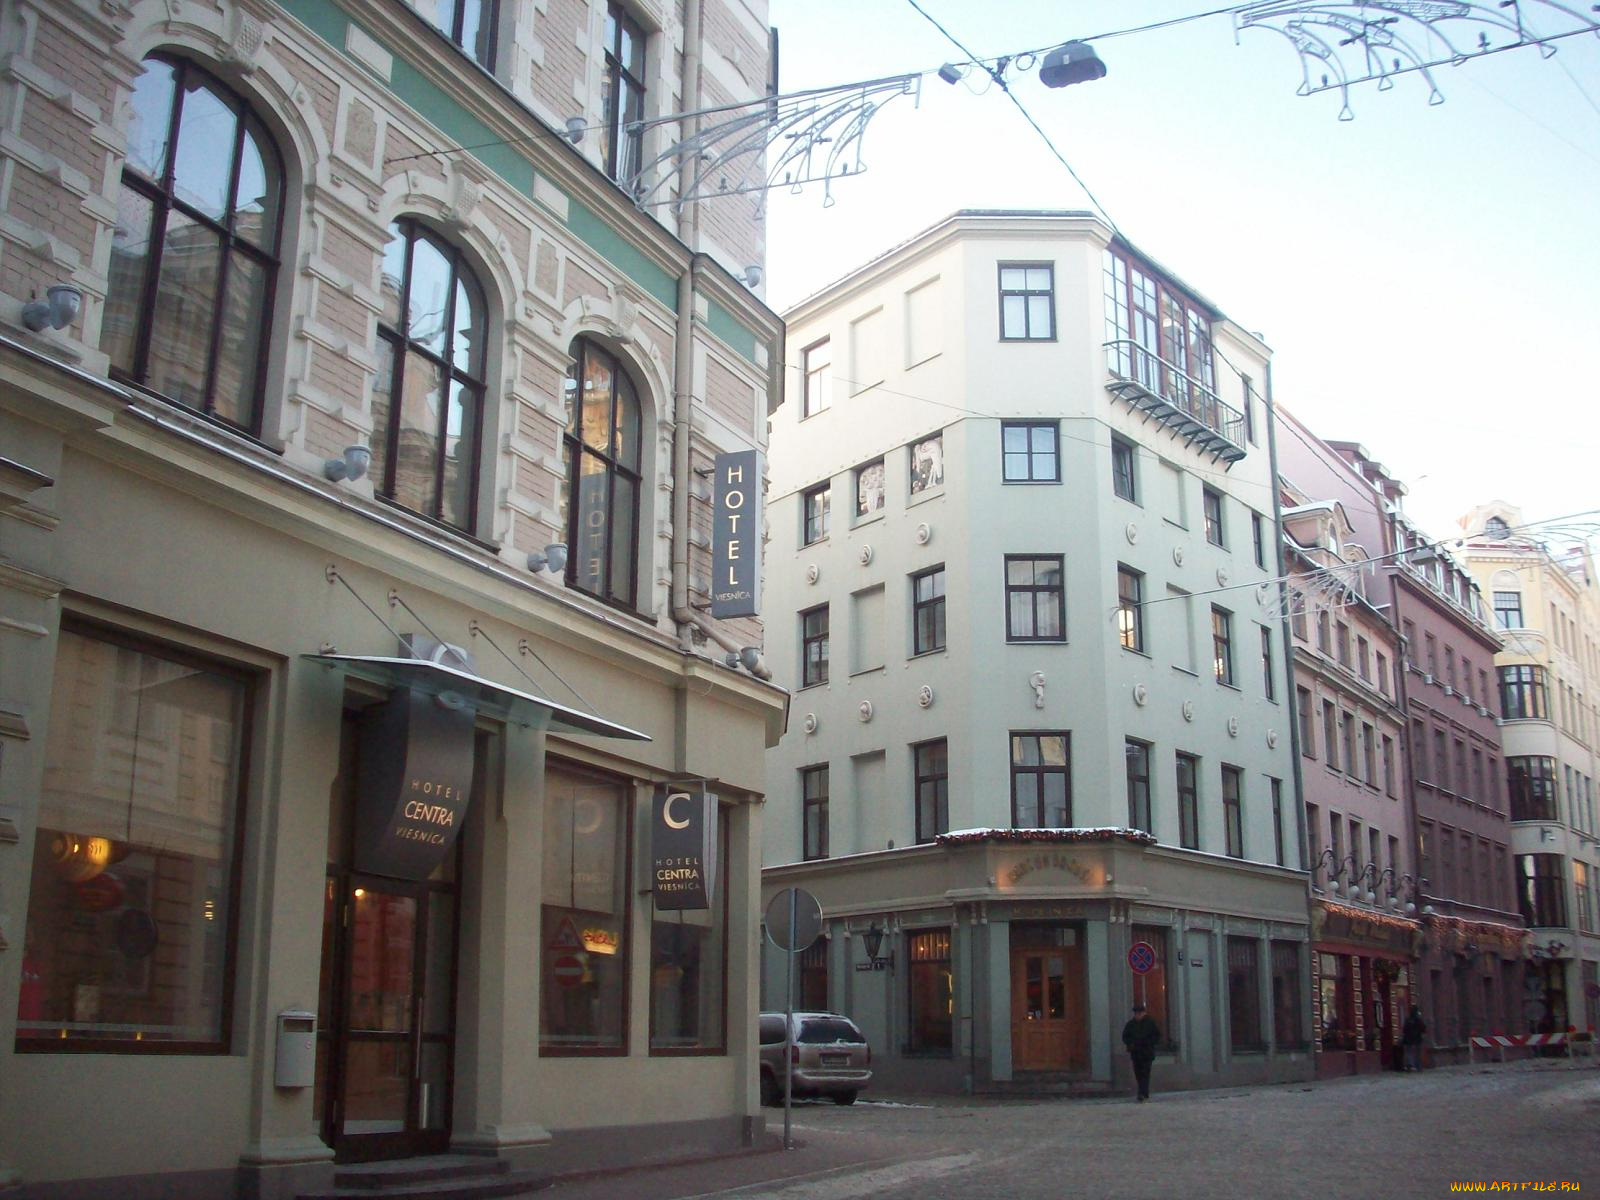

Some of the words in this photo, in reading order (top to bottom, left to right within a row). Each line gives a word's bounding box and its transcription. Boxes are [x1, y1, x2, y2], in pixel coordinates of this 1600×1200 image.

[725, 465, 744, 585] HOTEL
[412, 779, 461, 801] HOTEL
[404, 800, 454, 827] CENTRA
[663, 793, 690, 829] C
[656, 858, 699, 866] HOTEL
[656, 868, 700, 881] CENTRA
